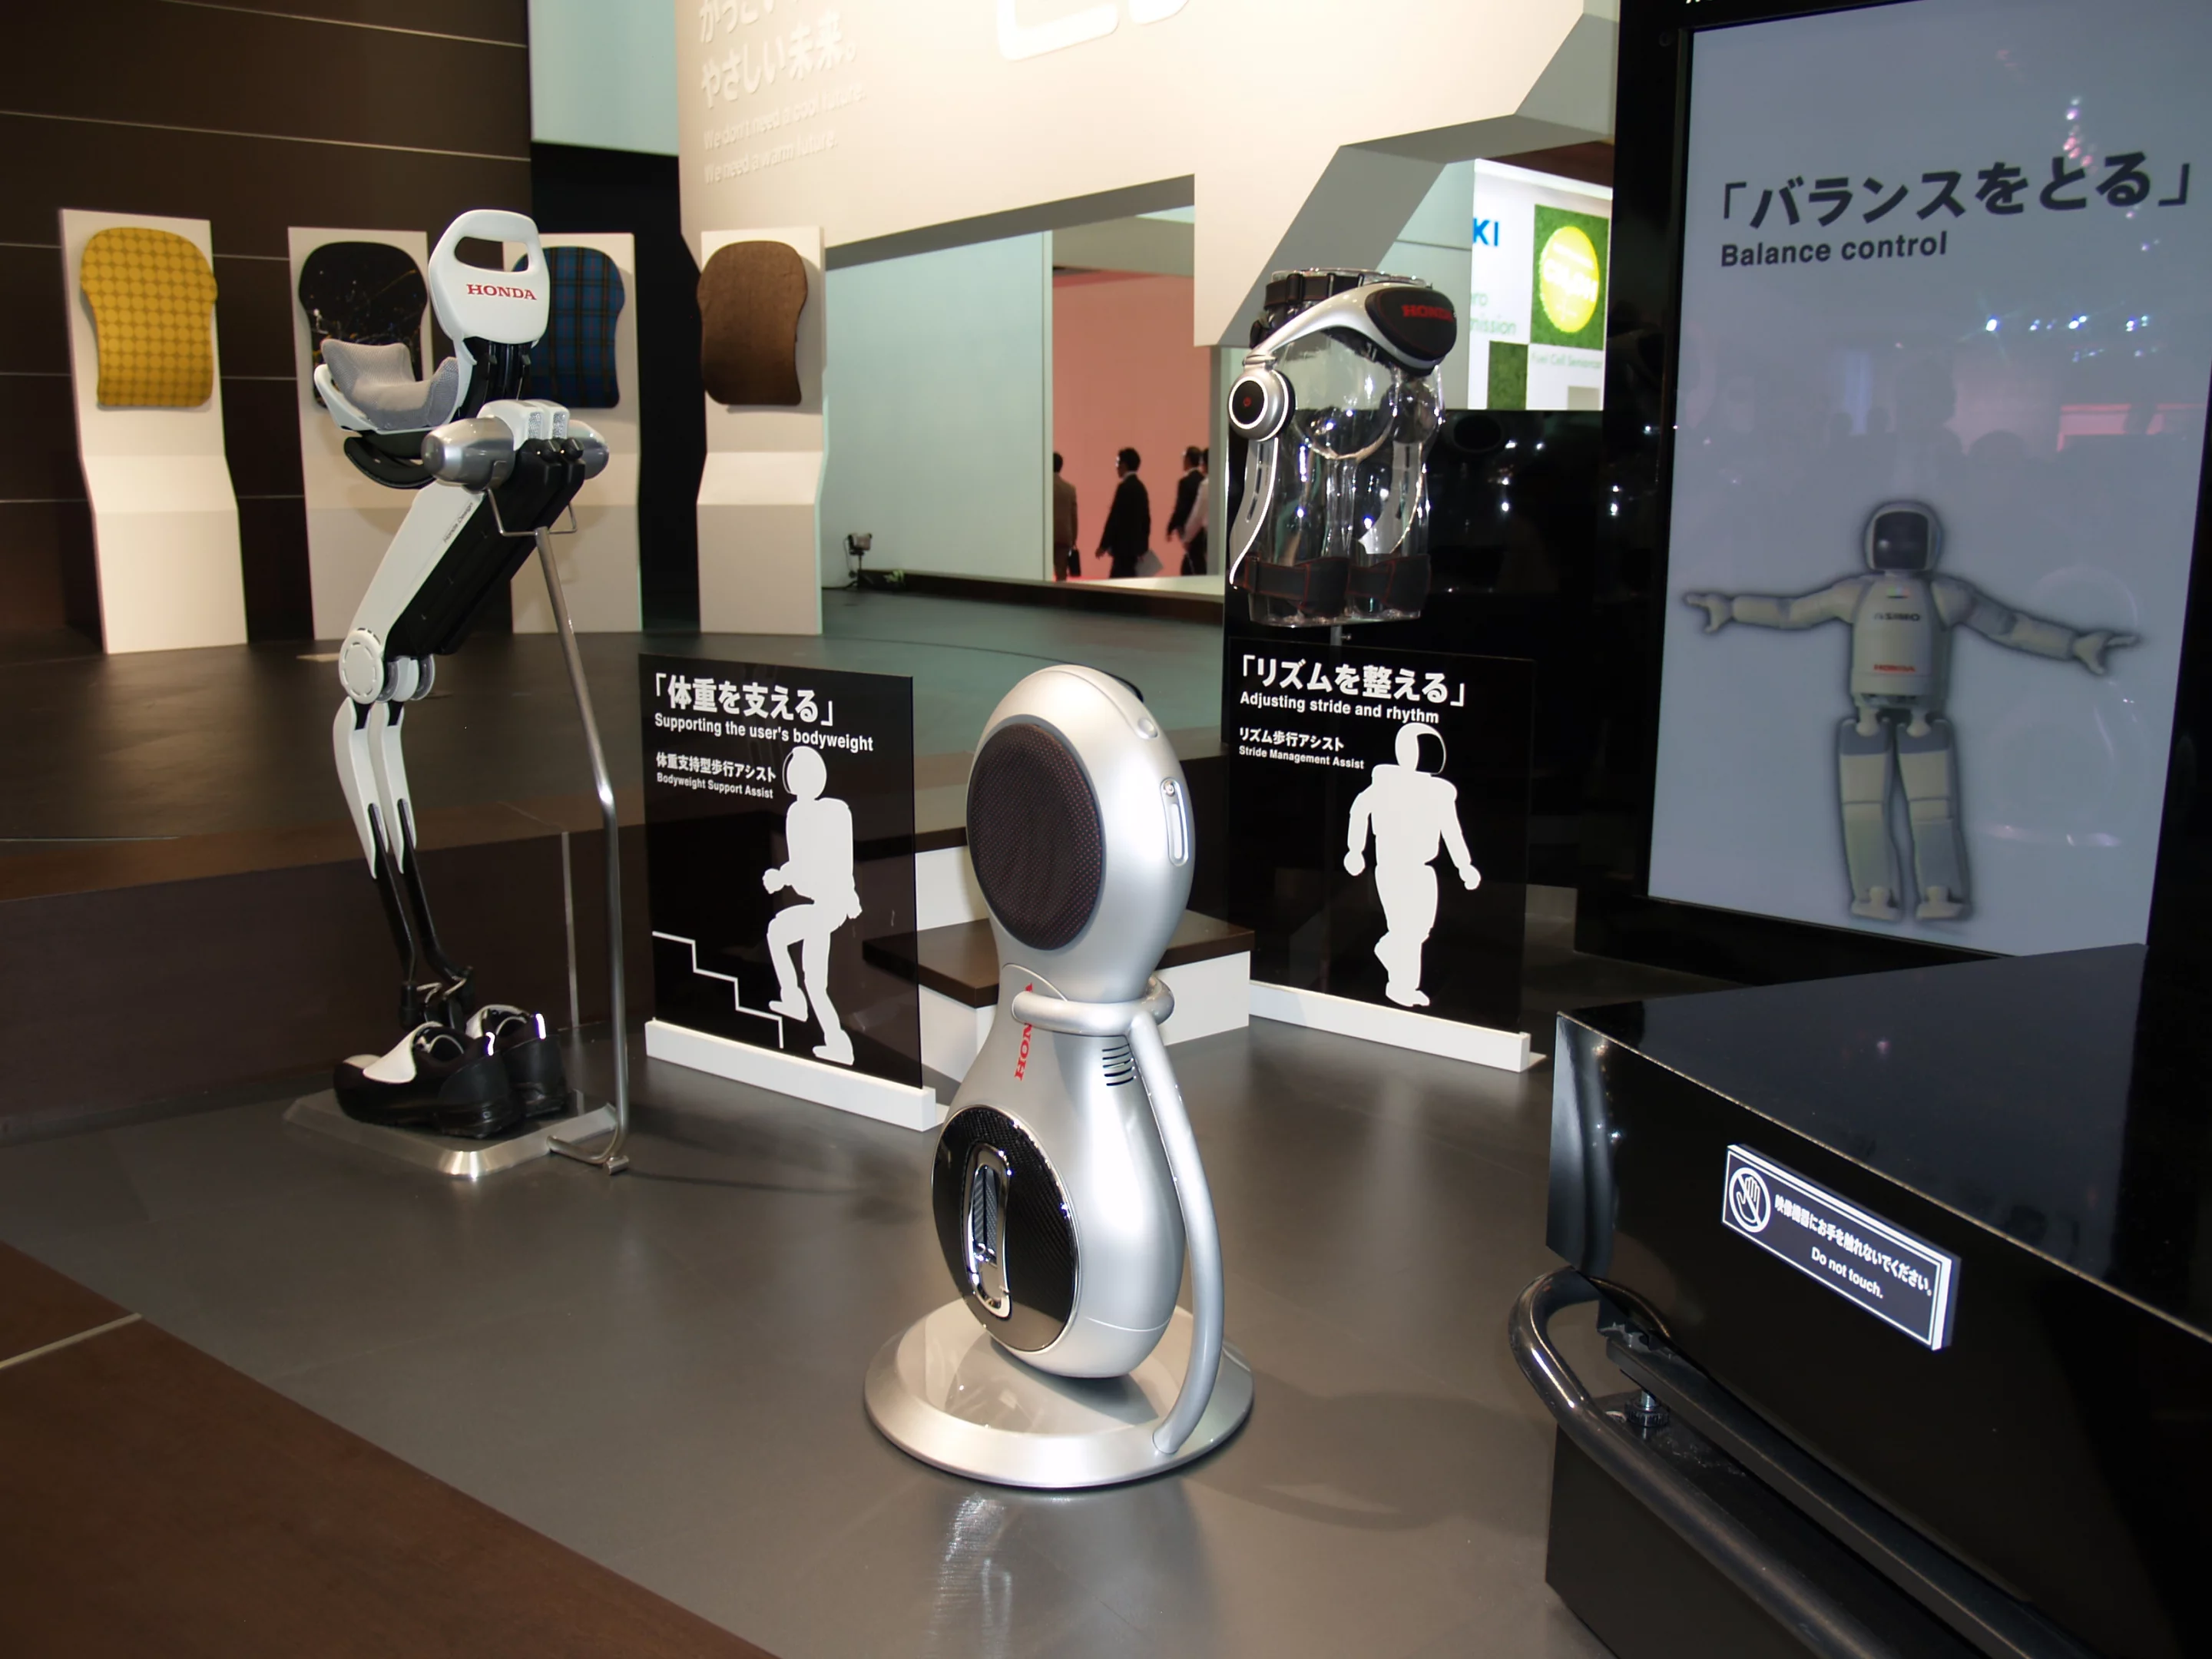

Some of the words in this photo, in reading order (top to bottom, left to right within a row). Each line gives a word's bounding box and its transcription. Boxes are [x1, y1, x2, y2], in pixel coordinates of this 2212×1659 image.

[701, 7, 857, 110] やさしい未来。
[703, 129, 722, 151] We
[753, 107, 780, 134] need
[704, 163, 722, 185] We
[723, 153, 749, 179] need
[752, 154, 760, 171] a
[761, 142, 795, 167] warm
[796, 129, 839, 157] future.
[1722, 151, 2190, 230] 「バランスをとる」
[1720, 240, 1831, 268] Balance
[1840, 230, 1948, 262] control
[465, 283, 538, 300] HONDA
[655, 672, 833, 727] 「体重を支える」
[1242, 654, 1465, 707] 「リズムを整える」
[1240, 691, 1306, 713] Adjusting
[1309, 698, 1351, 715] stride
[1354, 703, 1382, 719] and
[1386, 706, 1439, 724] rhythm
[654, 712, 722, 737] Supporting
[725, 720, 746, 737] the
[749, 726, 790, 743] user's
[793, 727, 874, 753] bodyweight
[1239, 727, 1344, 753] リズム歩行アシスト
[656, 751, 777, 783] 体重支持型歩行アシスト
[1239, 745, 1267, 759] Stride
[1269, 749, 1330, 766] Management
[1332, 756, 1364, 770] Assist
[657, 772, 706, 790] Bodyweight
[707, 780, 743, 795] Support
[744, 784, 773, 799] Assist
[1811, 1246, 1827, 1265] Do
[1829, 1258, 1848, 1278] not
[1848, 1268, 1884, 1299] touch.
